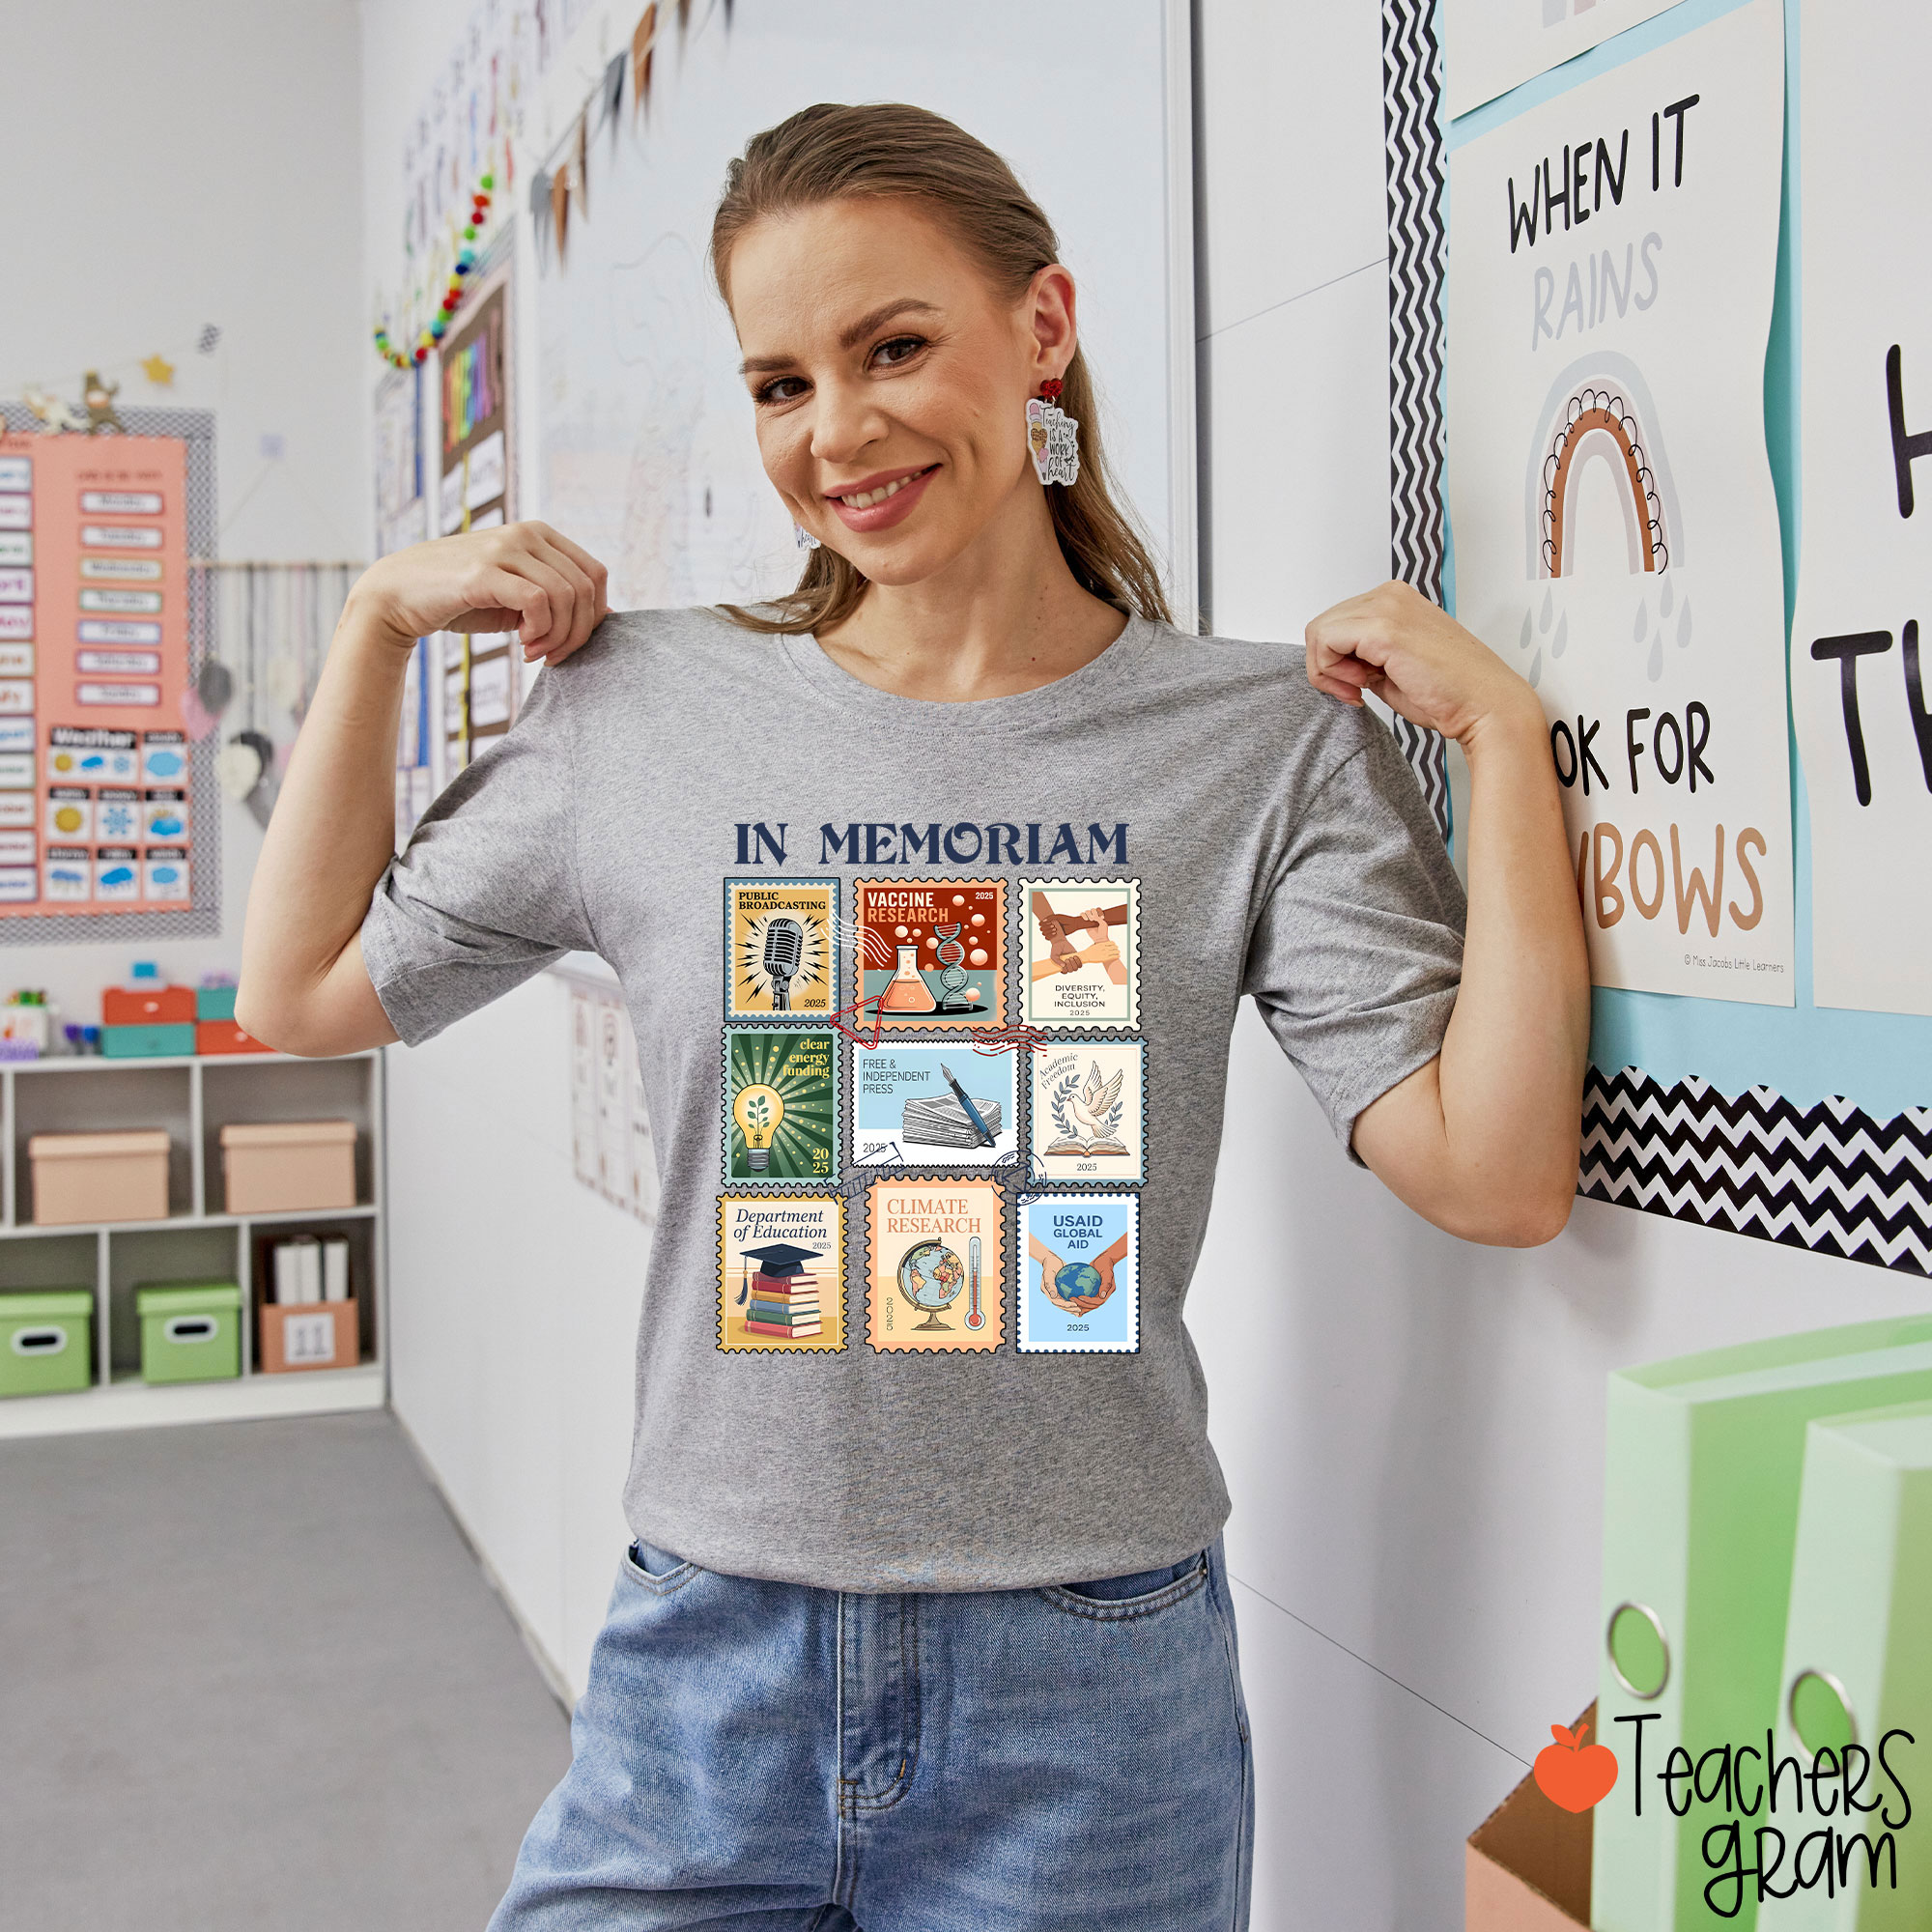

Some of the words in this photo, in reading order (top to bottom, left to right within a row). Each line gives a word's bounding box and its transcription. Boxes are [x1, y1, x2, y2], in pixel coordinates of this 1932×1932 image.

[1508, 128, 1629, 254] WHEN
[1652, 94, 1700, 191] IT
[1532, 232, 1662, 352] RAINS
[1039, 405, 1075, 439] Teaching
[1049, 442, 1069, 456] WORK
[1047, 456, 1076, 482] heart
[1550, 715, 1609, 797] OK
[1627, 700, 1715, 794] FOR
[734, 823, 788, 867] IN
[819, 822, 1130, 866] MEMORIAM
[1577, 822, 1767, 938] BOWS
[738, 892, 780, 900] PUBLIC
[867, 892, 934, 907] VACCINE
[975, 892, 994, 900] 2025
[738, 901, 826, 910] BROADCASTING
[867, 908, 949, 923] RESEARCH
[1692, 954, 1706, 967] Miss
[1708, 955, 1732, 969] Jacobs
[1734, 957, 1750, 971] Little
[1753, 959, 1784, 974] Learners
[804, 999, 827, 1008] 2025
[799, 1037, 830, 1050] clear
[788, 1053, 830, 1065] energy
[863, 1059, 887, 1069] FREE
[889, 1059, 896, 1069] &
[1038, 1052, 1079, 1080] Academic
[782, 1064, 830, 1079] funding
[863, 1071, 931, 1081] INDEPENDENT
[1040, 1063, 1075, 1090] Freedom
[863, 1084, 894, 1094] PRESS
[812, 1148, 829, 1159] 20
[863, 1143, 887, 1152] 2025
[812, 1161, 829, 1174] 25
[1076, 1163, 1097, 1172] 2025
[887, 1199, 969, 1214] CLIMATE
[735, 1208, 823, 1226] Department
[1053, 1215, 1103, 1227] USAID
[886, 1217, 981, 1233] RESEARCH
[733, 1225, 751, 1242] of
[753, 1225, 828, 1239] Education
[1053, 1229, 1103, 1238] GLOBAL
[812, 1241, 832, 1250] 2025
[1067, 1239, 1089, 1249] AID
